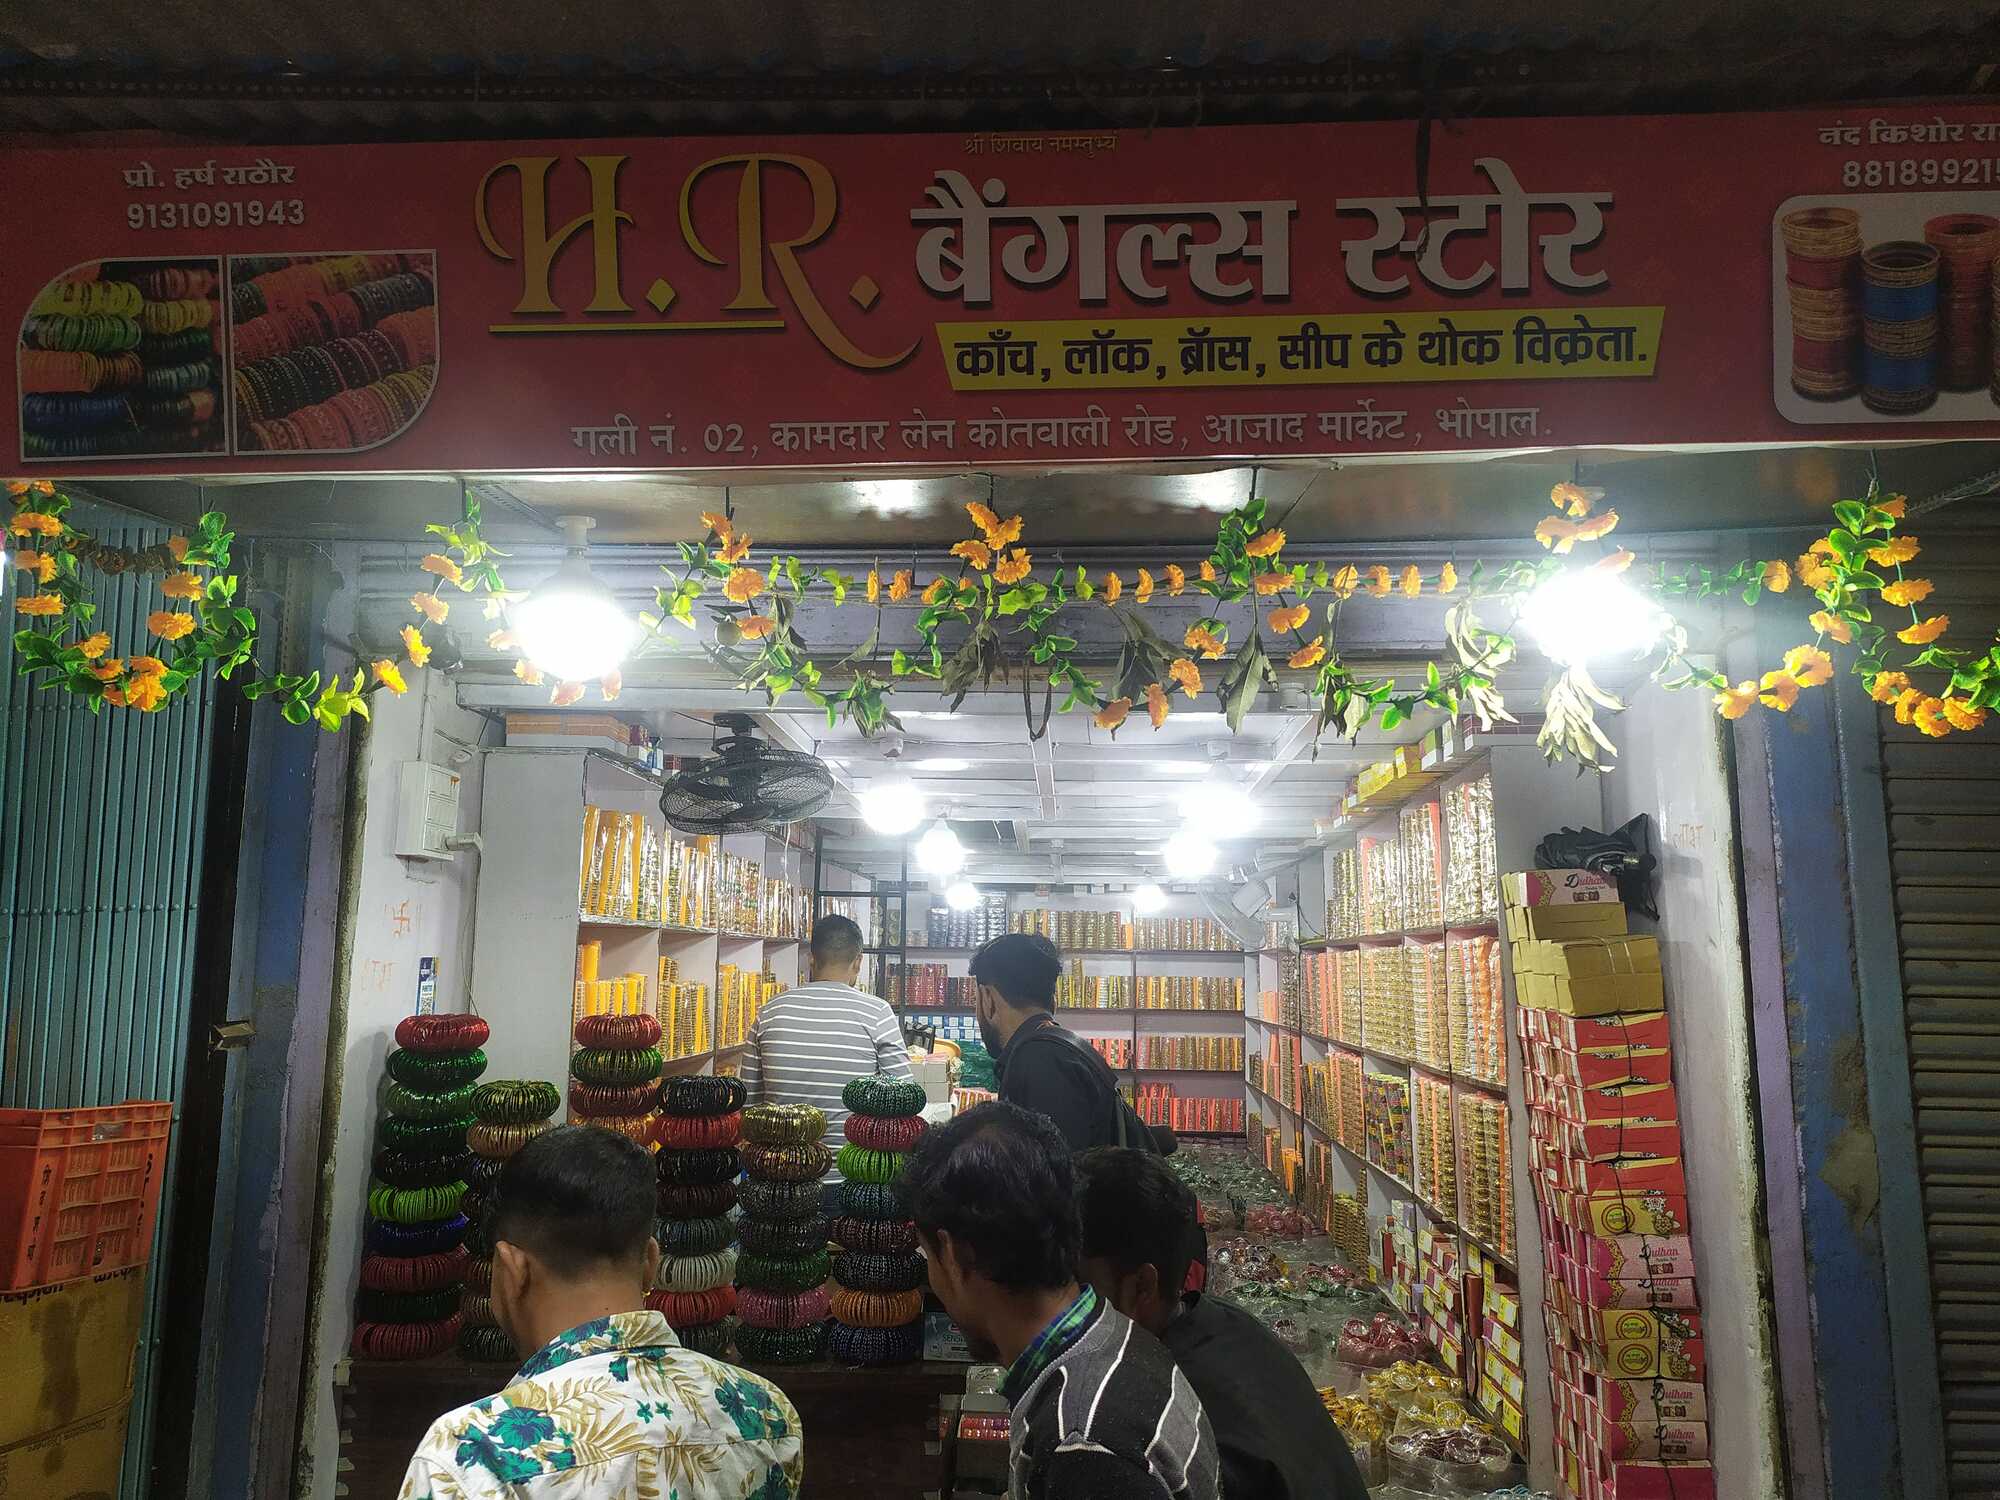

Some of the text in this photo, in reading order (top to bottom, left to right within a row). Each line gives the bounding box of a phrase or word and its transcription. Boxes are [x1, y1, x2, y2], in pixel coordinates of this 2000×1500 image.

[965, 132, 984, 154] श्री
[991, 133, 1043, 153] शिवाय
[1818, 117, 2000, 145] नंद किशोर रा
[123, 158, 295, 189] प्रो. हर्ष राठौर
[127, 199, 305, 230] 9131091943
[910, 157, 1613, 303] बैंगल्स स्टोर
[1063, 328, 1167, 380] लॉक,
[1178, 326, 1266, 379] ब्रॉस,
[1278, 319, 1351, 369] सीप
[1363, 319, 1405, 367] के
[1418, 317, 1503, 366] थोक
[1512, 314, 1648, 366] विक्रेता.
[571, 396, 1551, 459] गली नं. 02, कामदार लेन कोतवाली रोड, आजाद मार्केट, भोपाल.
